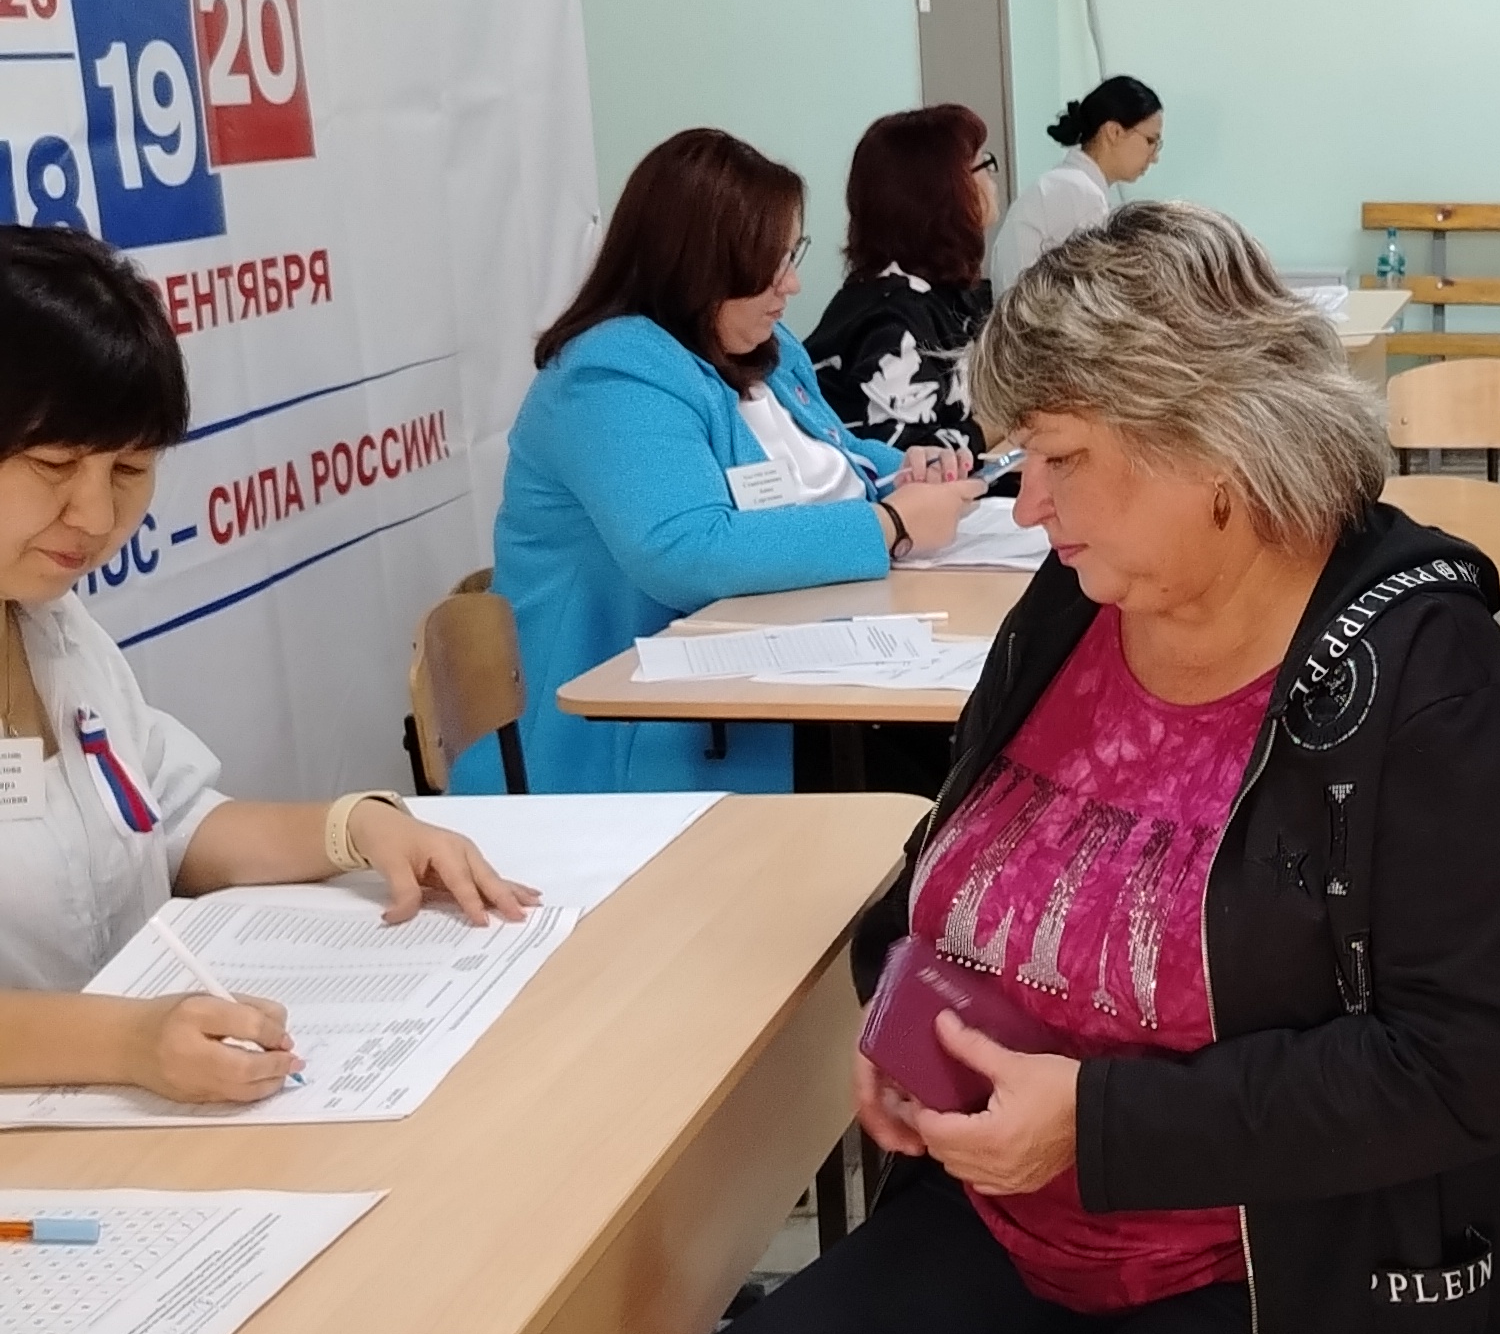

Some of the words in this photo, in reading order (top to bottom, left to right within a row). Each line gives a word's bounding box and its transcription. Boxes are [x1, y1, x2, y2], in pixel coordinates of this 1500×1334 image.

[95, 39, 197, 190] 19
[148, 249, 333, 338] ЕНТЯБРЯ
[208, 460, 305, 545] СИЛА
[310, 409, 451, 505] РОССИИ!
[1387, 1252, 1494, 1304] PLEIN
